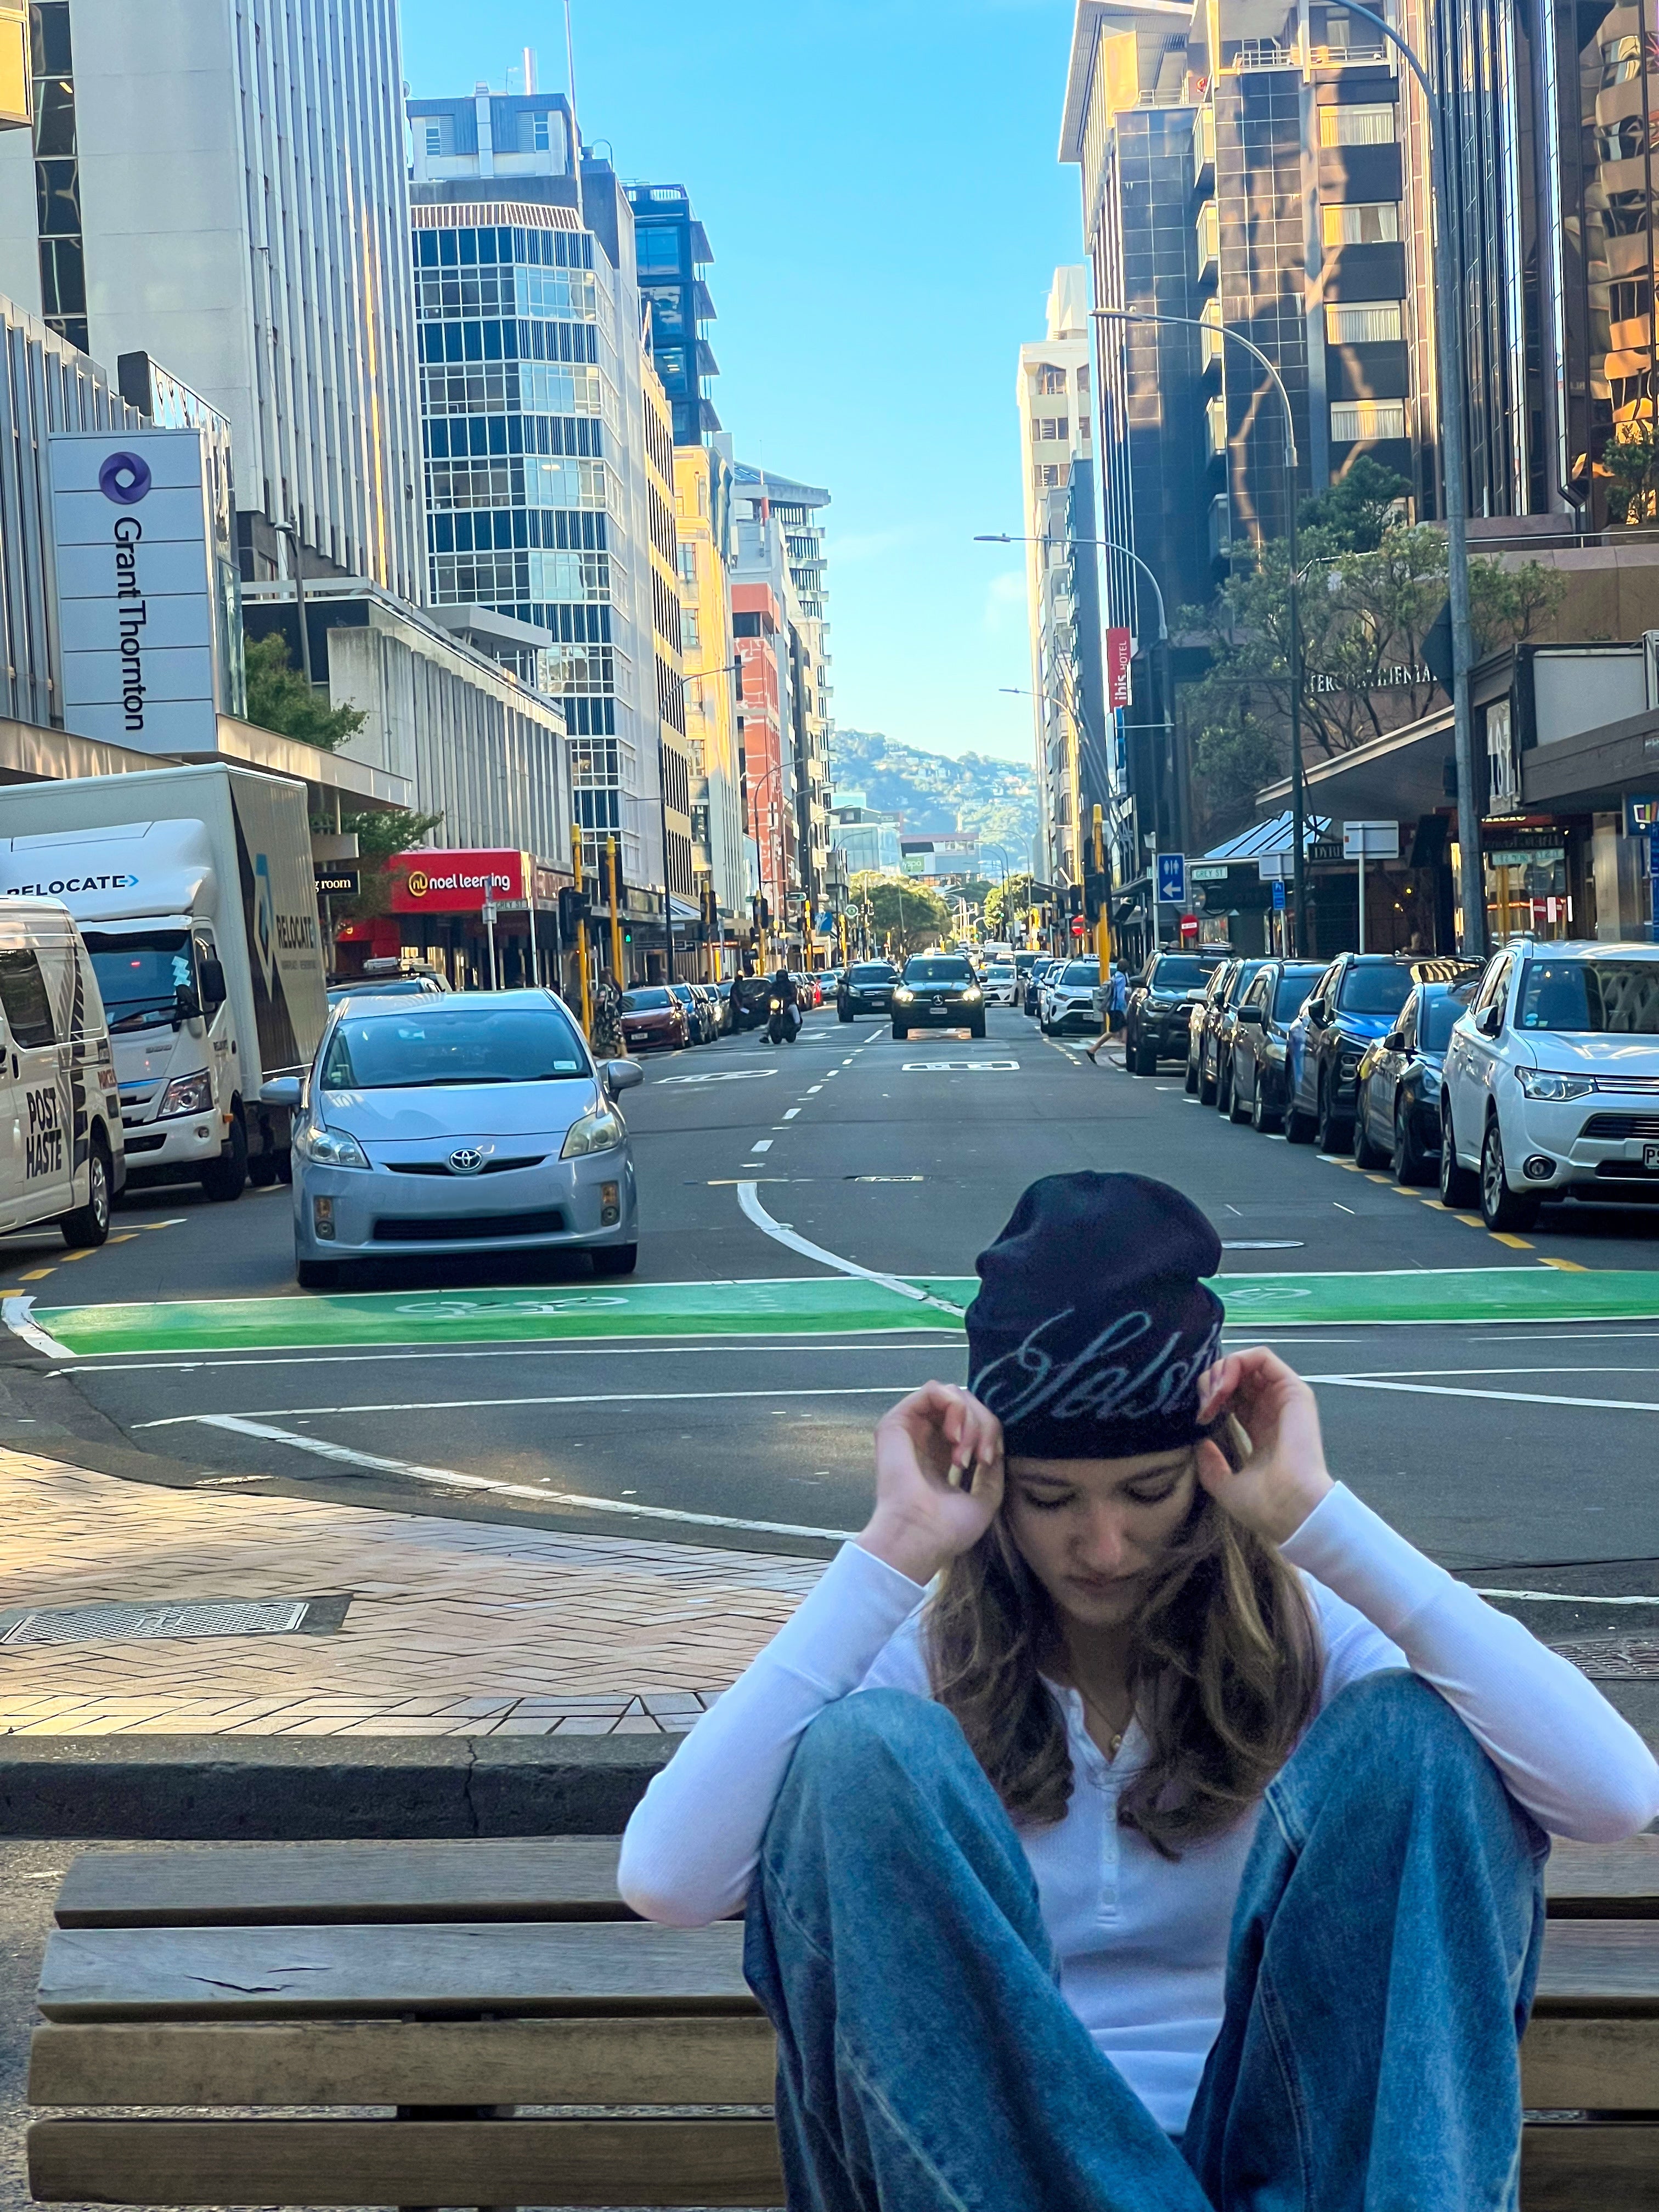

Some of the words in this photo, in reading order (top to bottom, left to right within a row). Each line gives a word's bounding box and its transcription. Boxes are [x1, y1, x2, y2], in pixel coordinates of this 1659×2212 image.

[114, 517, 142, 599] Grant
[119, 600, 147, 731] Thornton
[1119, 640, 1127, 670] HOTEL
[1114, 675, 1127, 700] ibis
[321, 879, 351, 889] room
[430, 873, 457, 889] noel
[1196, 869, 1212, 878] GREY
[1216, 868, 1223, 876] ST
[276, 915, 314, 949] RELOCATE
[26, 1087, 58, 1134] POST
[26, 1128, 62, 1180] HASTE
